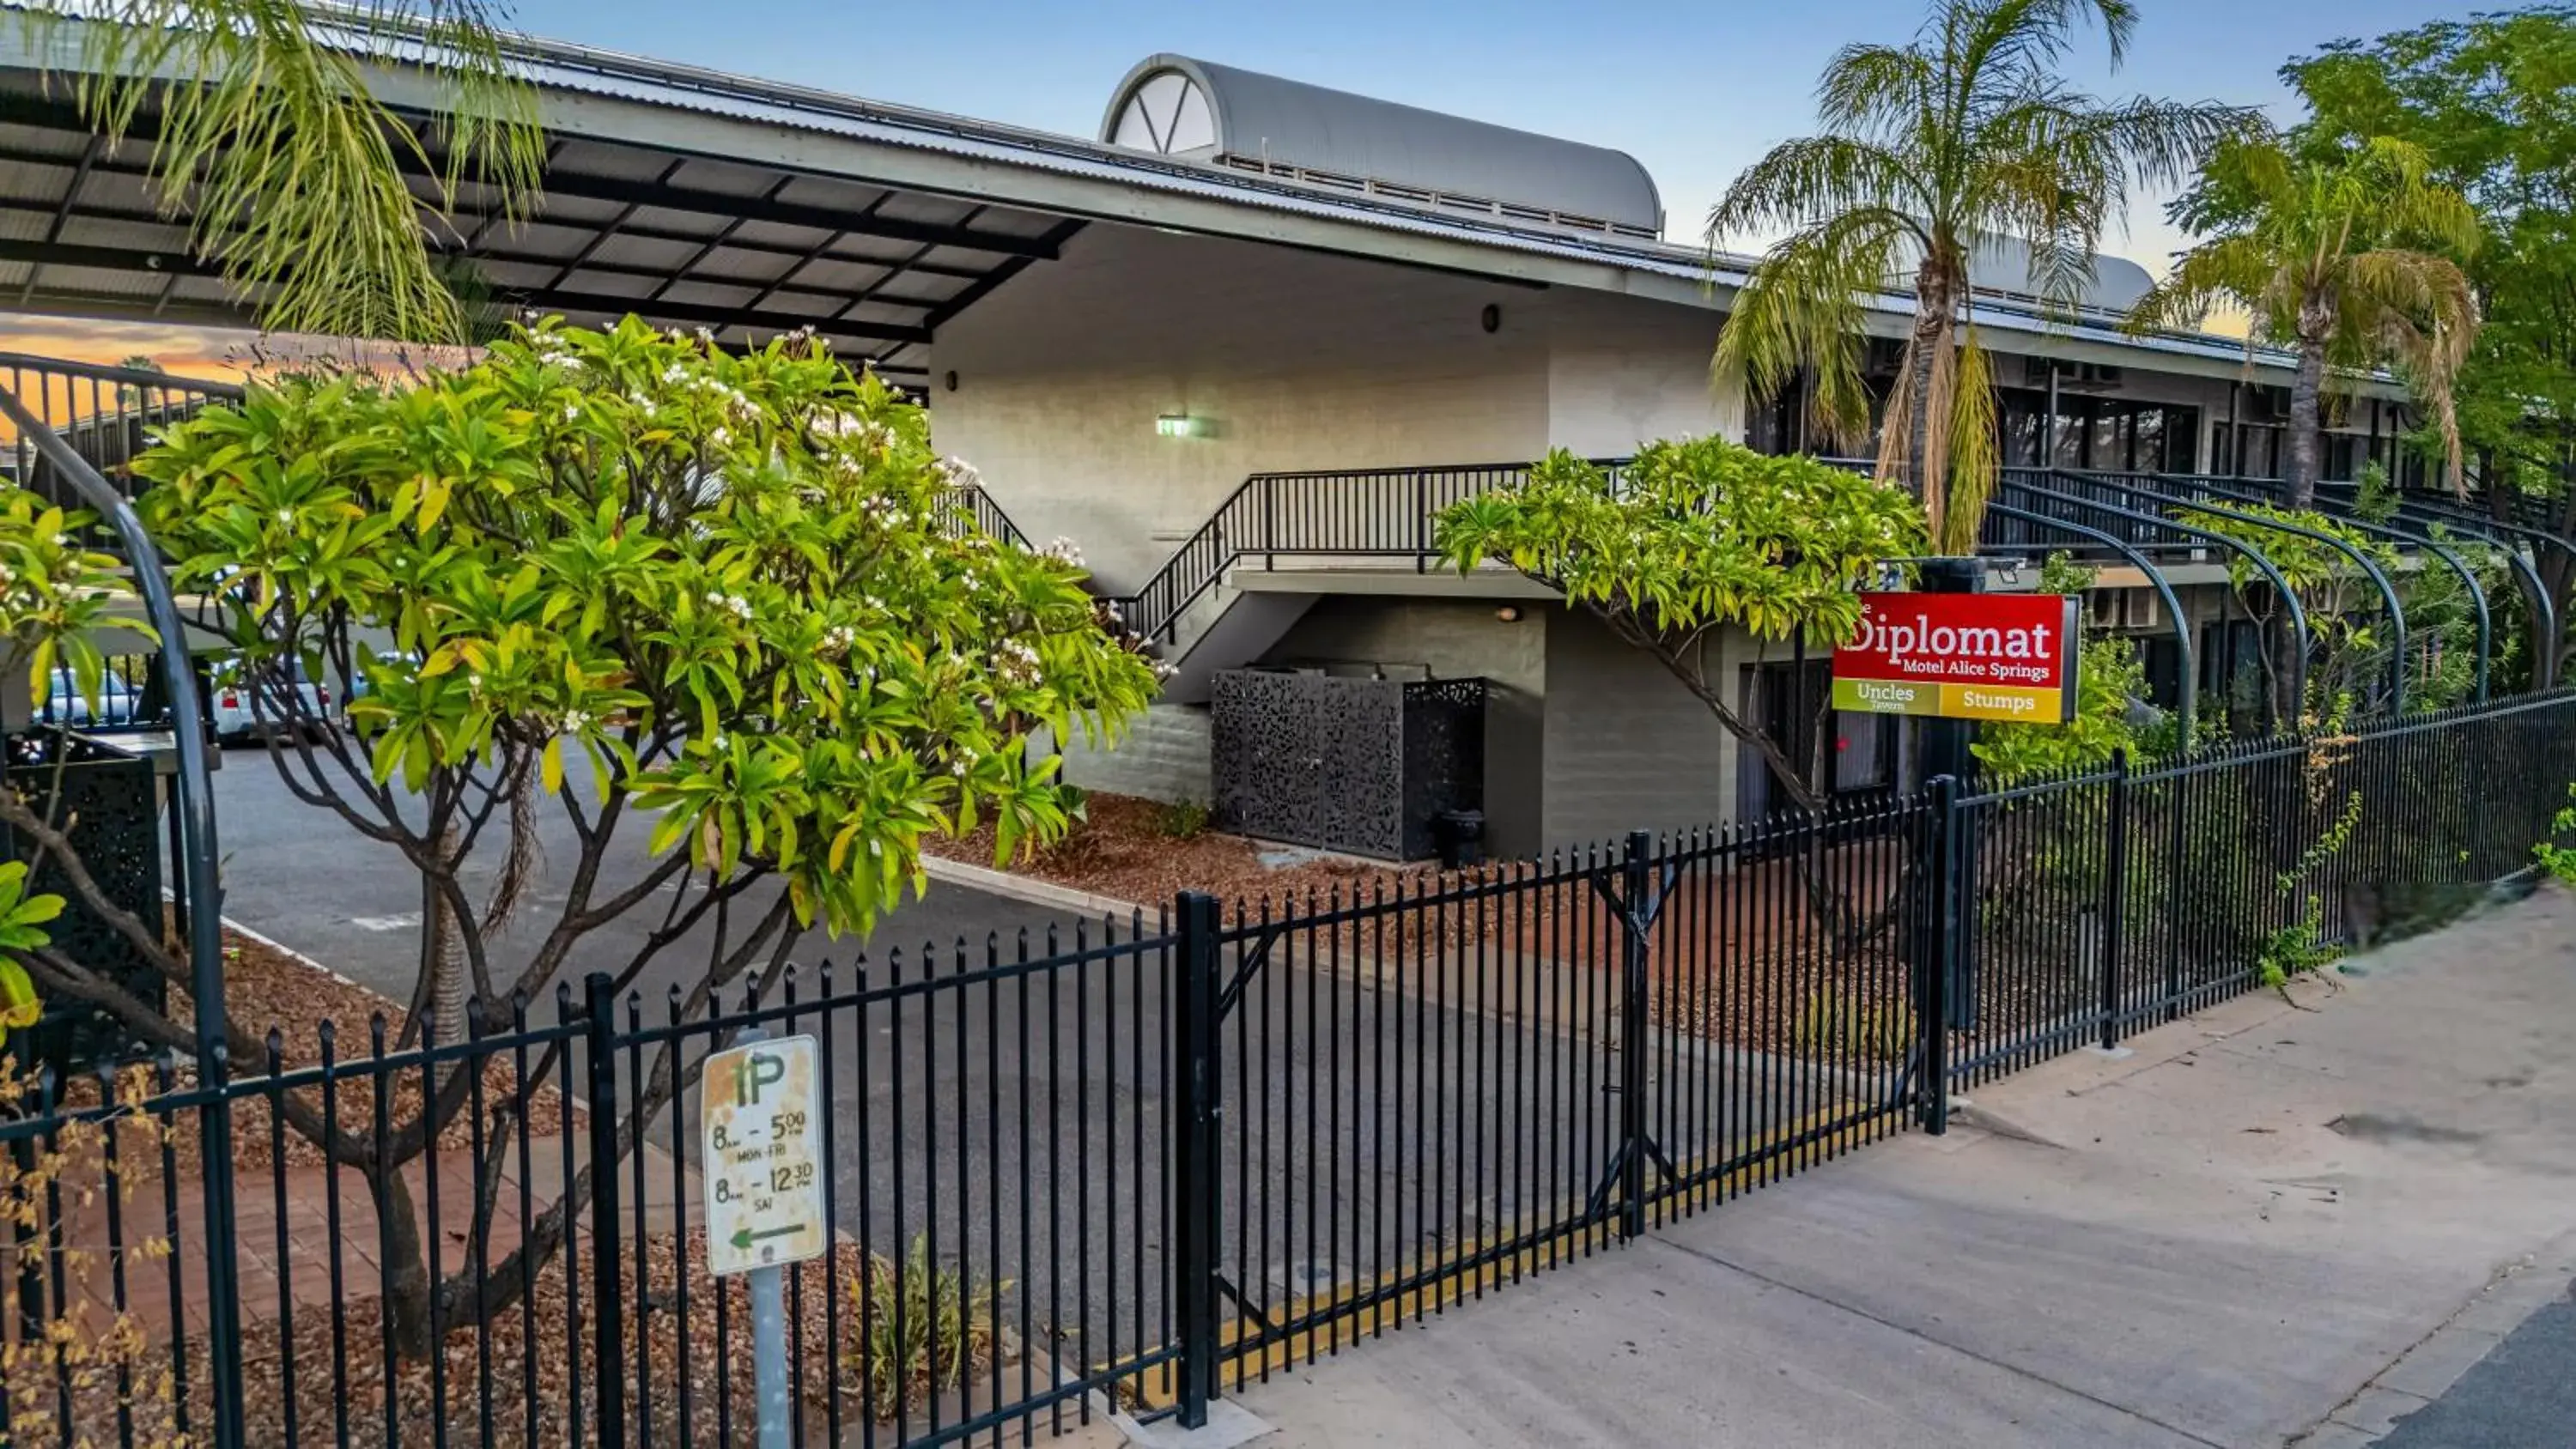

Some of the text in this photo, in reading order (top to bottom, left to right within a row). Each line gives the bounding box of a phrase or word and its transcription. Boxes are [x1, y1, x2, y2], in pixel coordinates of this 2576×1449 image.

[1842, 613, 2051, 664] Diplomat
[1903, 658, 2050, 682] Motel Alice Springs
[1857, 682, 1915, 701] Uncles
[1964, 690, 2034, 712] Stumps
